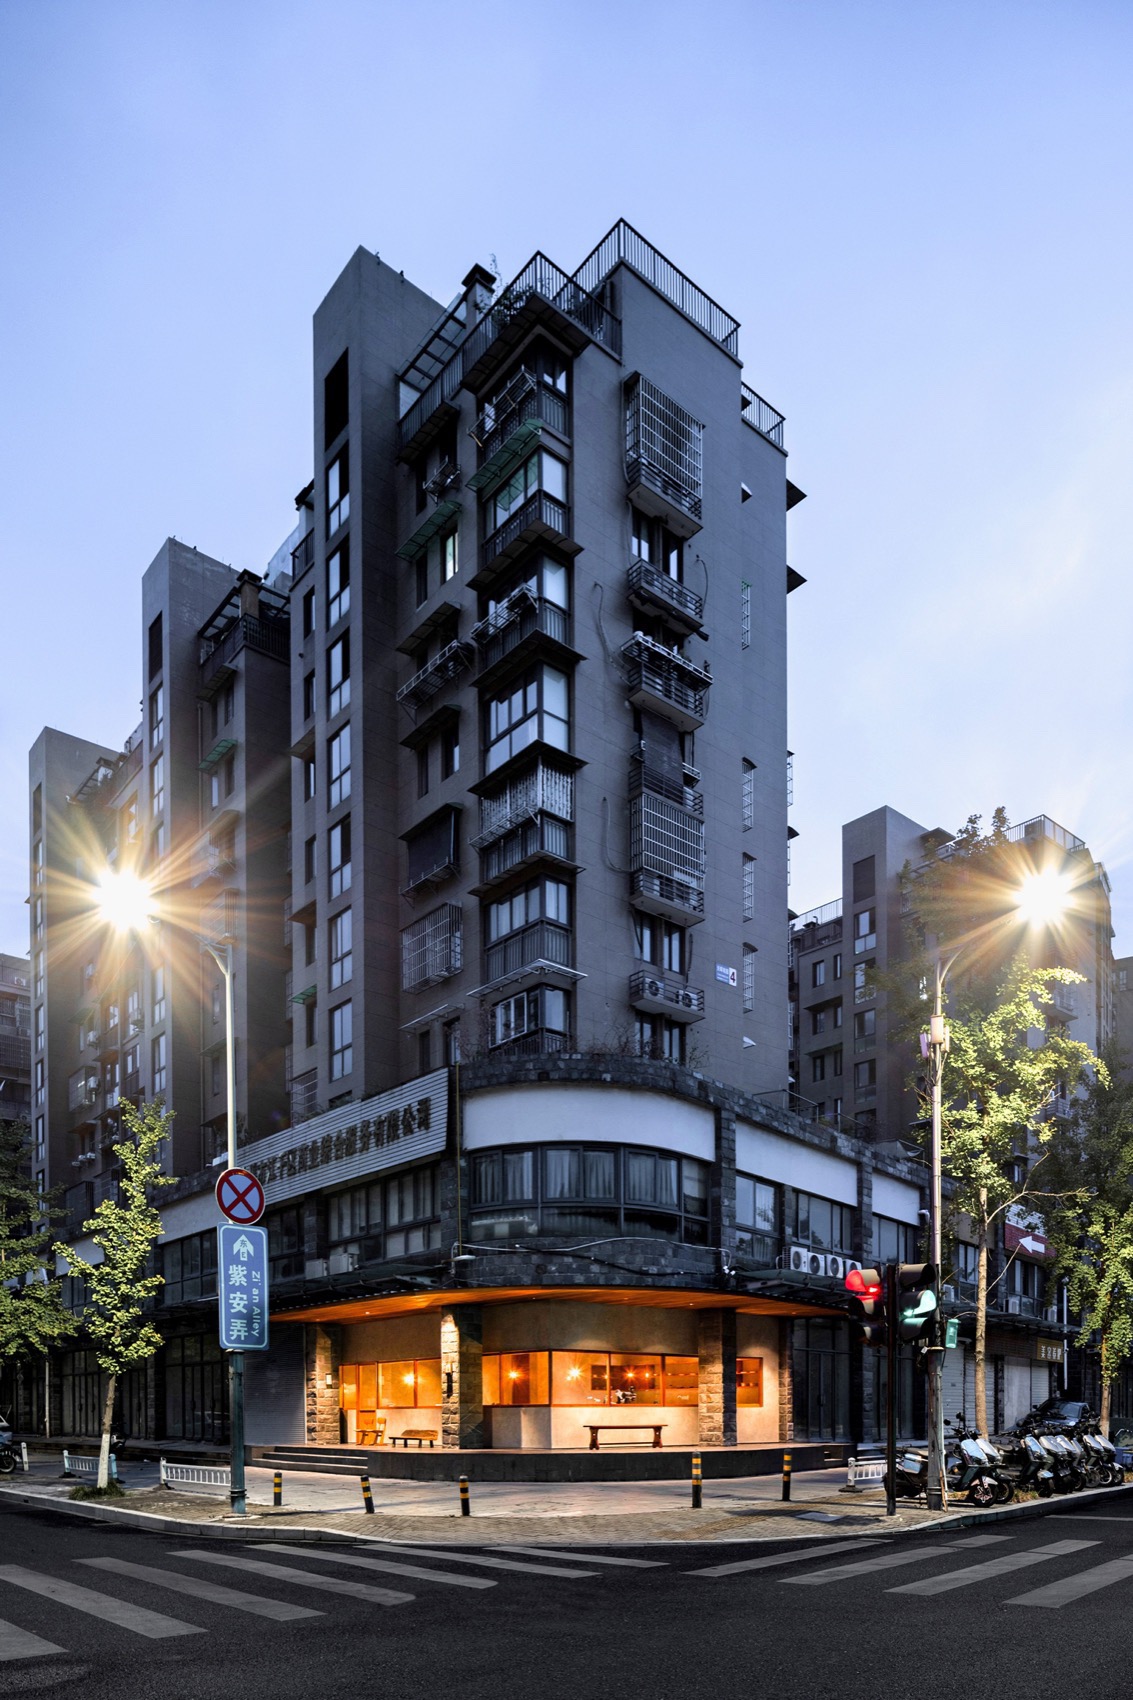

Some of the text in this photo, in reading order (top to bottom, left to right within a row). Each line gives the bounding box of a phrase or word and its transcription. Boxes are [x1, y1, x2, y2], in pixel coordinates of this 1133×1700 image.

[730, 972, 736, 983] 4
[239, 1239, 248, 1248] 东
[241, 1251, 246, 1259] E
[228, 1264, 249, 1341] 紫安弄
[251, 1306, 261, 1337] Alley
